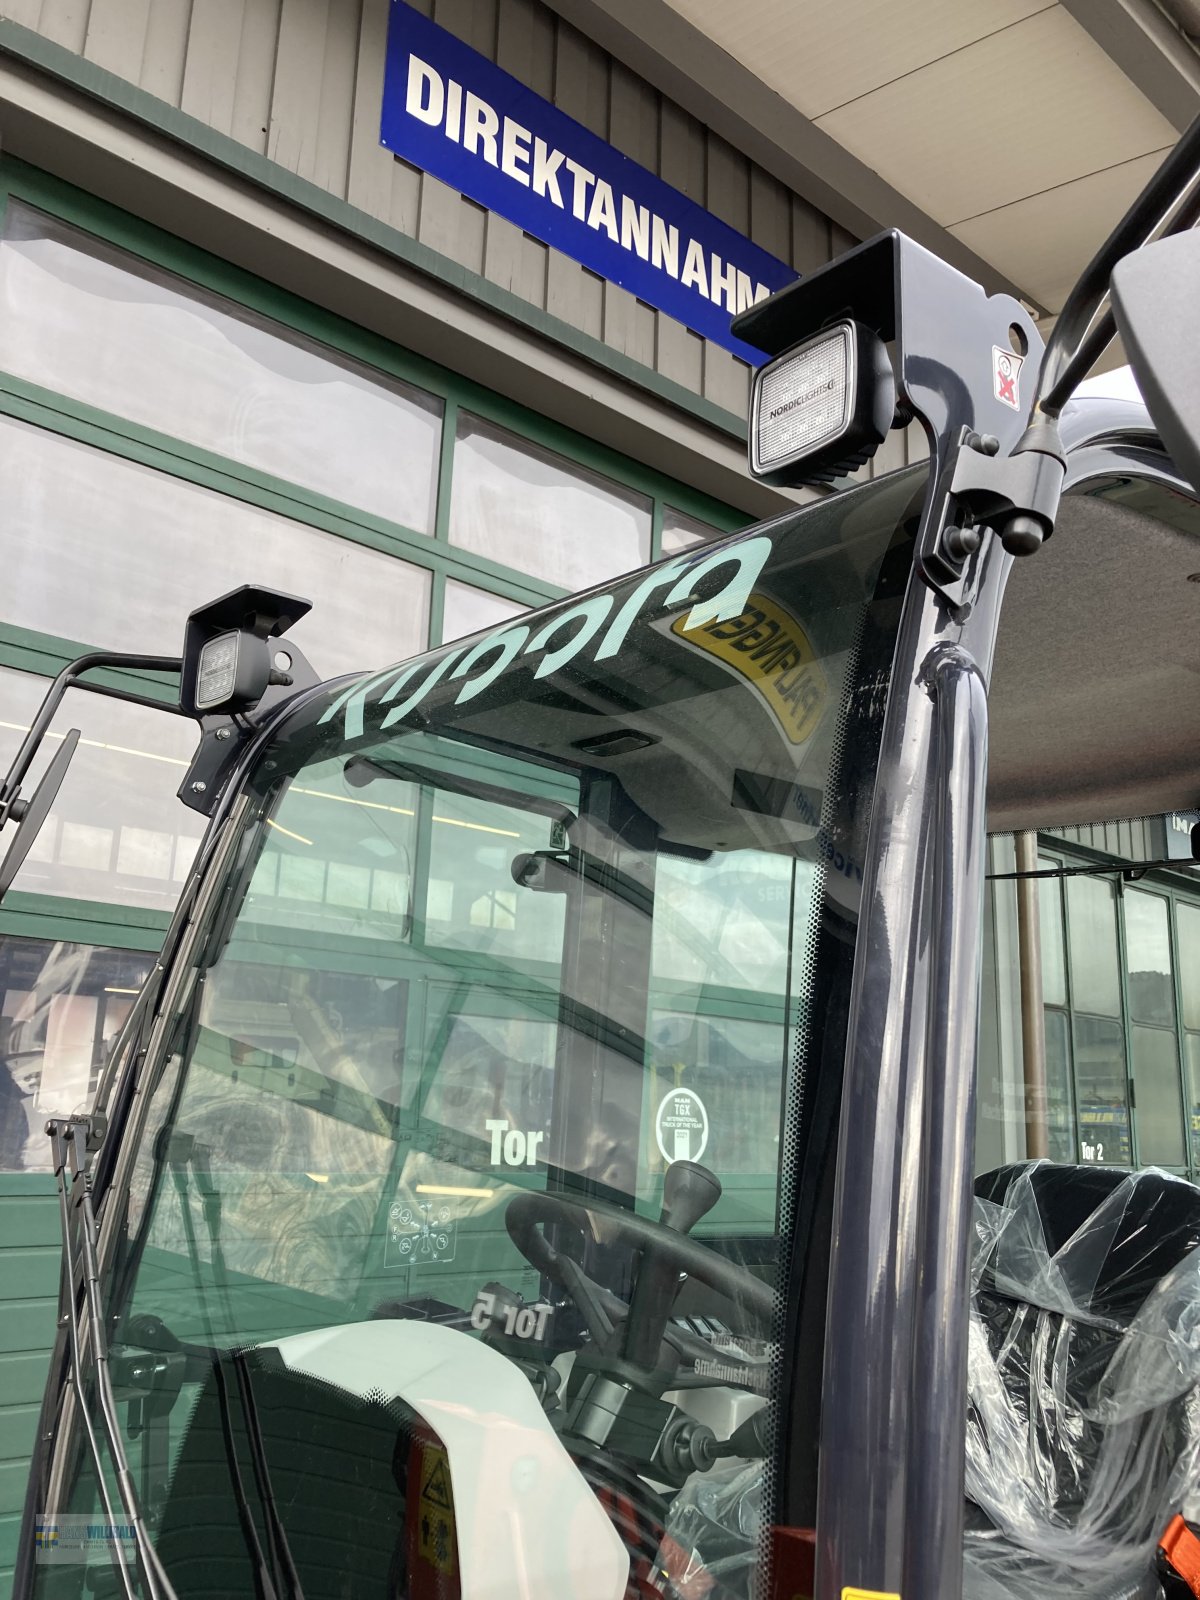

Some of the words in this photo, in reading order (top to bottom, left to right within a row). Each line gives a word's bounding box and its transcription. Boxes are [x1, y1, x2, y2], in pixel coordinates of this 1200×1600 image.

[405, 53, 779, 316] DIREKTANNAHM
[674, 1103, 691, 1116] TGX
[485, 1119, 544, 1166] Tor
[1081, 1141, 1095, 1161] Tor
[1096, 1142, 1104, 1161] 2
